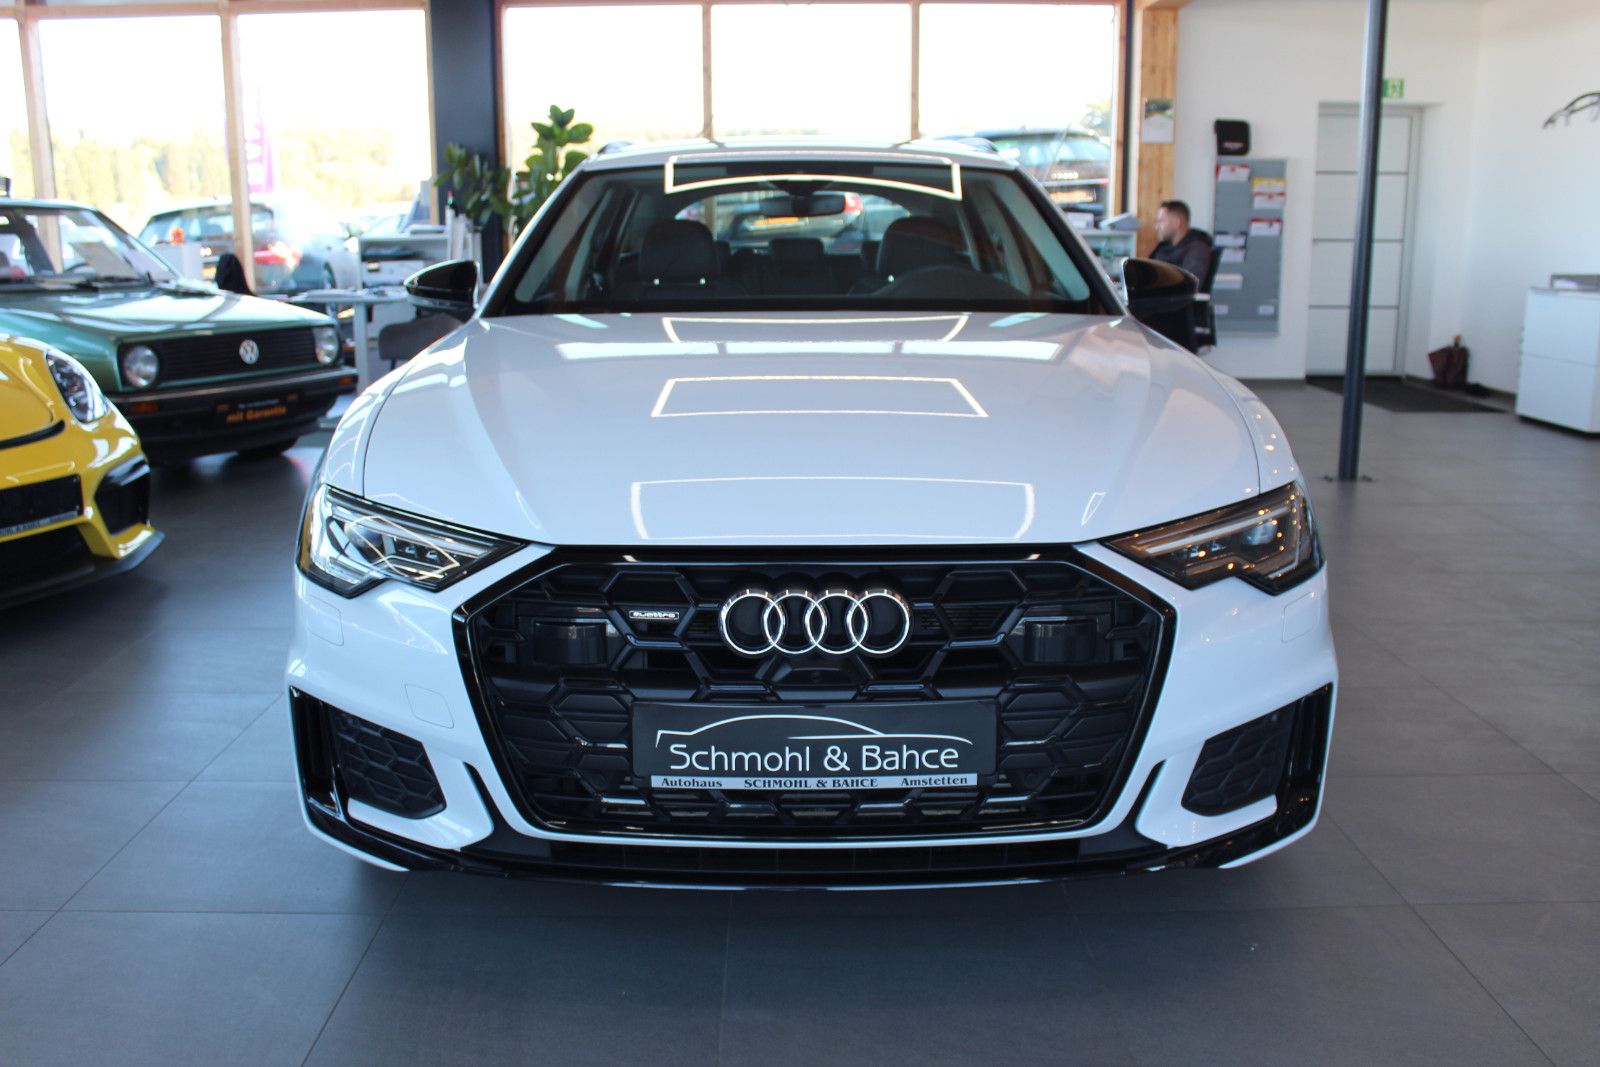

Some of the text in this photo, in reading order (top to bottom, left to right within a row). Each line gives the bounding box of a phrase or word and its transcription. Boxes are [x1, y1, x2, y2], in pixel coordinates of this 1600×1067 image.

[669, 743, 959, 772] Schmohl & Bahce
[661, 776, 968, 789] Autohaus SCHMOHL & BAHCE Amstetten
